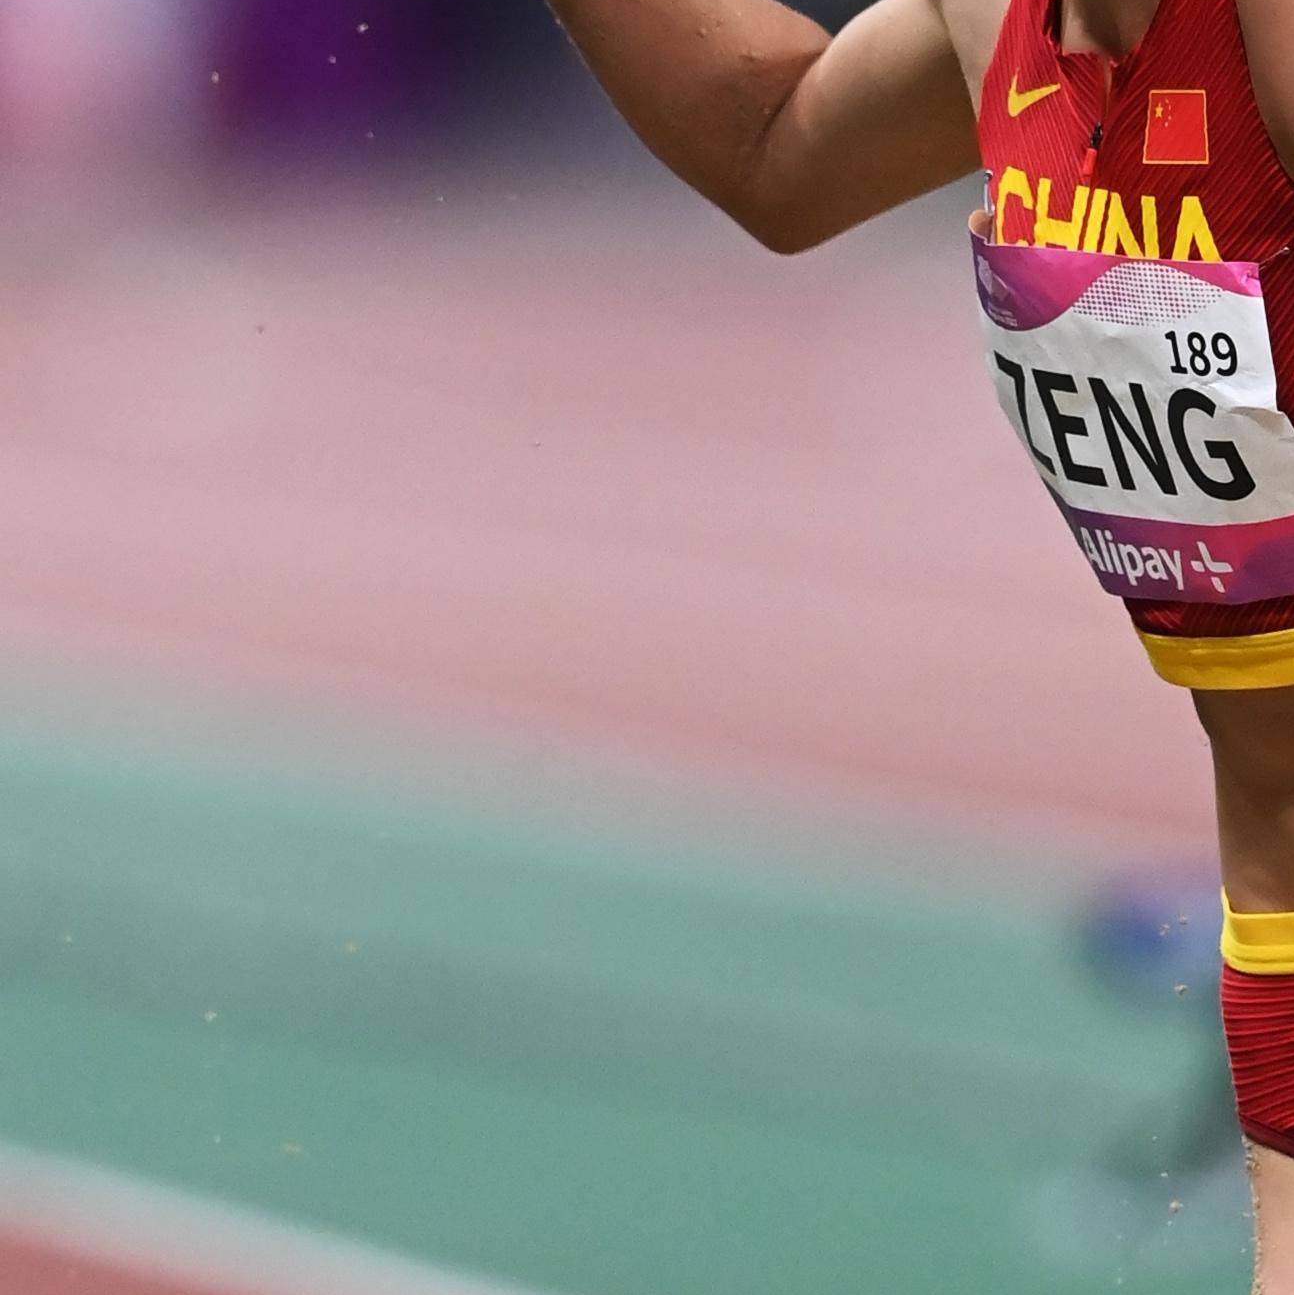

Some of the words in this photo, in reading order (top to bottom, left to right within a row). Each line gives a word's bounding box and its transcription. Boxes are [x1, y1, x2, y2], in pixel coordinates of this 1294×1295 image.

[996, 166, 1223, 262] CHINA
[1164, 330, 1238, 377] 189
[993, 350, 1257, 501] ZENG
[1080, 526, 1185, 590] Alipay
